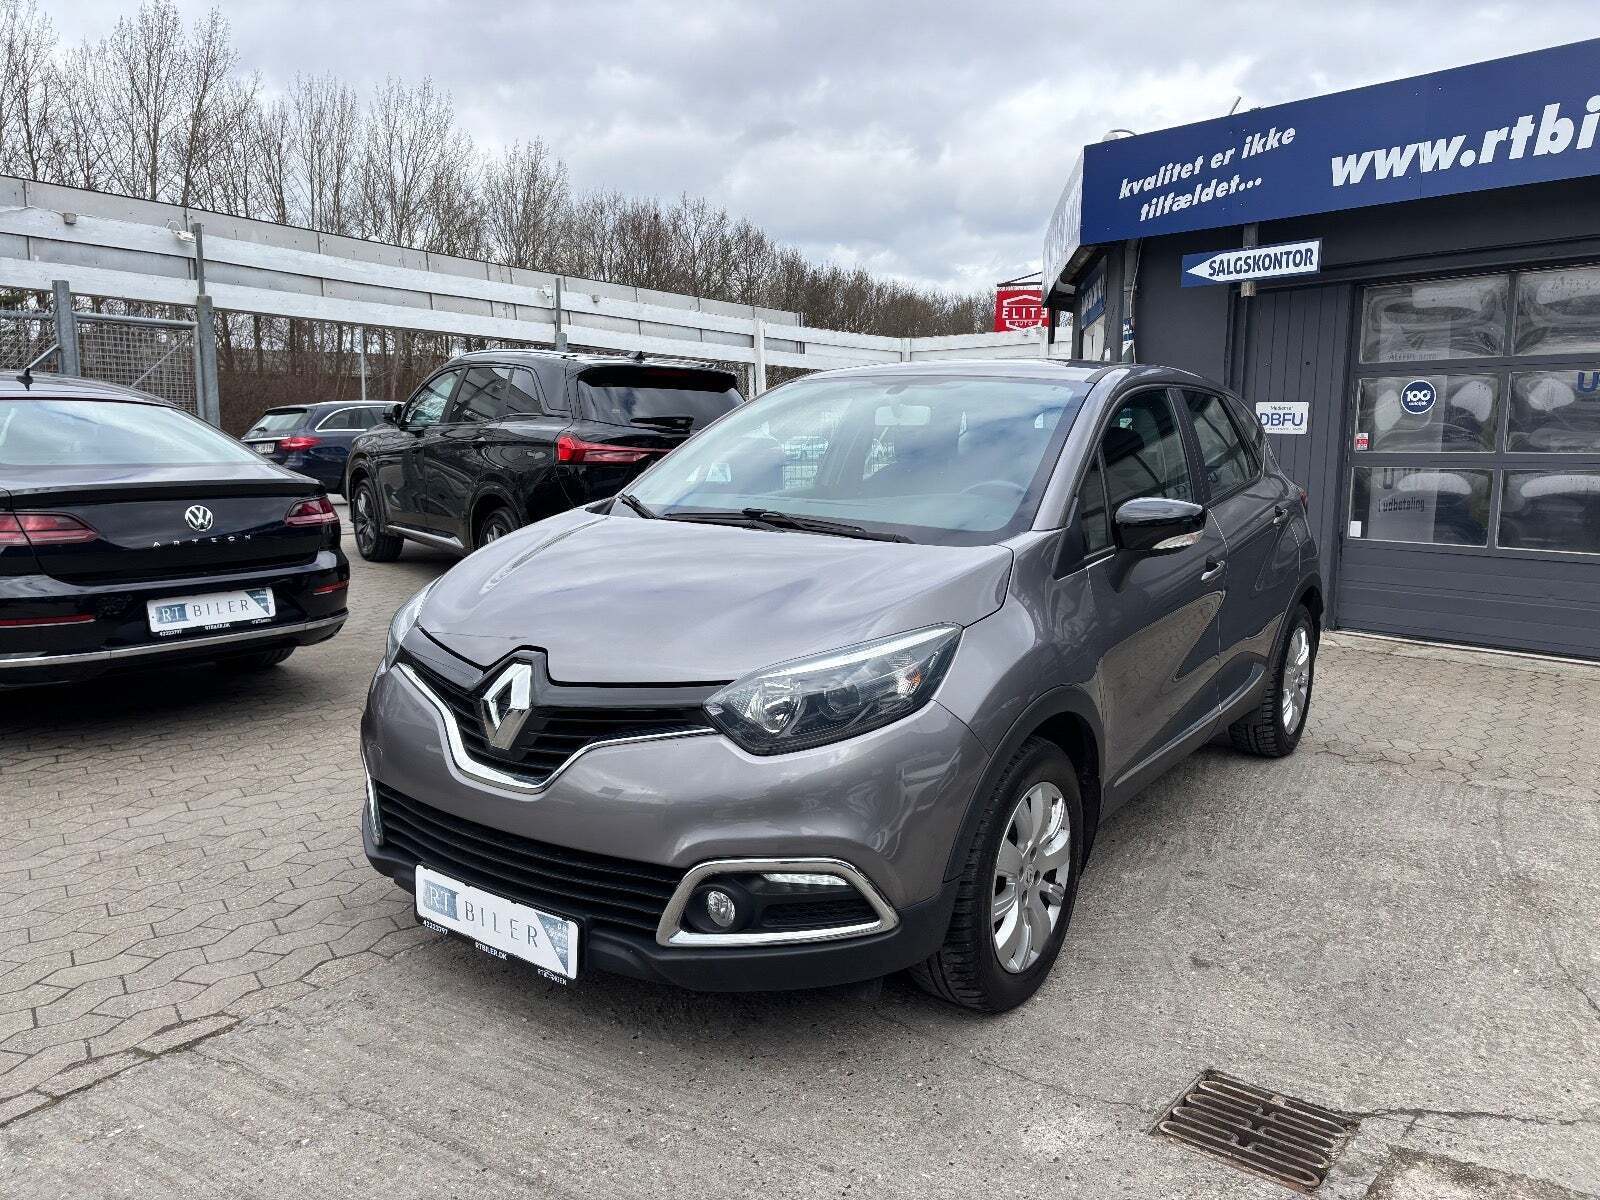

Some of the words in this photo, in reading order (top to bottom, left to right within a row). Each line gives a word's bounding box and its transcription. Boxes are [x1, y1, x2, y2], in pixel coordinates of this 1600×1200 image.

[1118, 155, 1204, 200] kvalitet
[1210, 147, 1236, 168] er
[1241, 127, 1296, 159] ikke
[1139, 174, 1262, 222] tilfældet...
[1208, 247, 1313, 277] SALGSKONTOR
[1002, 307, 1048, 319] ELITE
[1259, 412, 1304, 427] DBFU
[153, 534, 251, 548] ARTEON
[161, 606, 182, 623] RT
[193, 599, 249, 617] BILER
[429, 885, 451, 912] RT
[464, 900, 538, 948] BILER
[475, 941, 508, 960] RTBILER.DK
